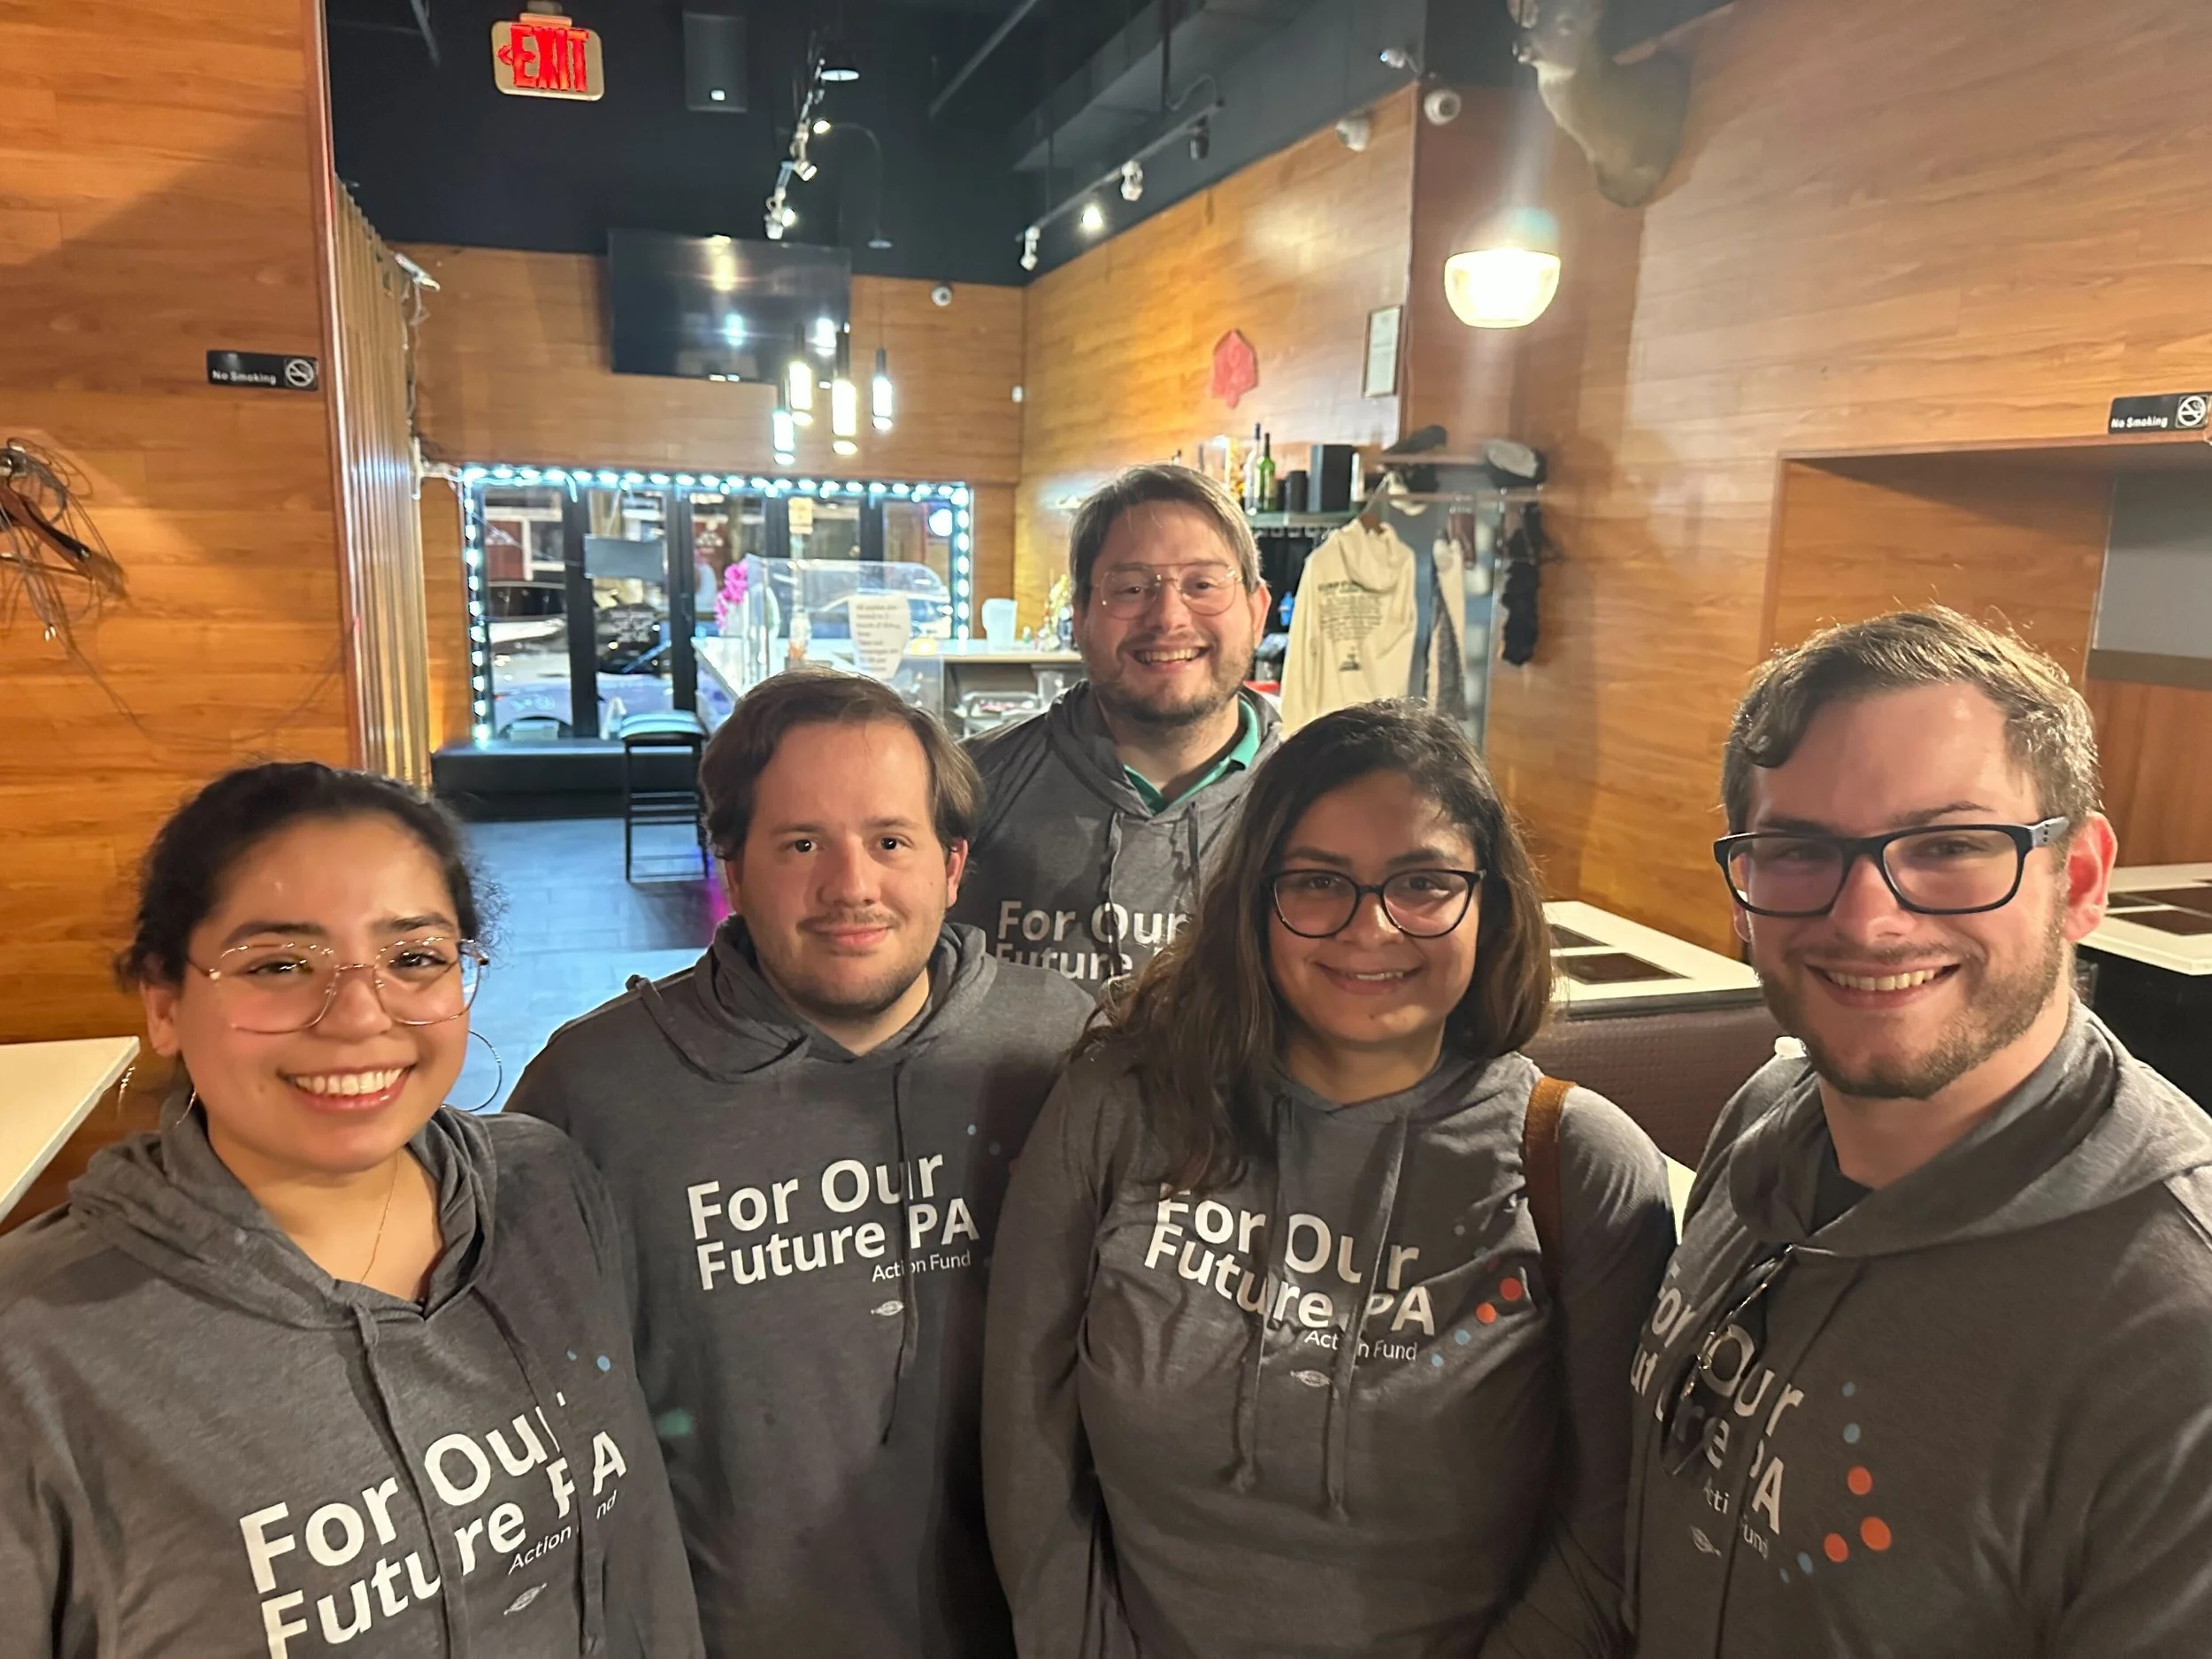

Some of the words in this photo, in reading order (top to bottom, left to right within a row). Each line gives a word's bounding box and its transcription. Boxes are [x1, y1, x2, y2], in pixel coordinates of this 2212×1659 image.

[511, 23, 588, 93] EXIT
[212, 369, 228, 380] No
[230, 371, 276, 386] Smoking
[2110, 417, 2124, 428] No
[2126, 415, 2168, 428] Smoking
[998, 900, 1077, 941] For
[1091, 901, 1193, 945] Our
[687, 1178, 799, 1240] For
[821, 1153, 943, 1213] Our
[1157, 1183, 1266, 1254] For
[696, 1220, 885, 1291] Future
[909, 1197, 980, 1249] PA
[930, 1249, 971, 1271] Fund
[1144, 1223, 1333, 1328] Future
[1304, 1330, 1370, 1358] Actn
[1374, 1340, 1417, 1361] Fund
[239, 1477, 398, 1594] For
[508, 1525, 572, 1576] Action
[261, 1502, 526, 1659] Future
